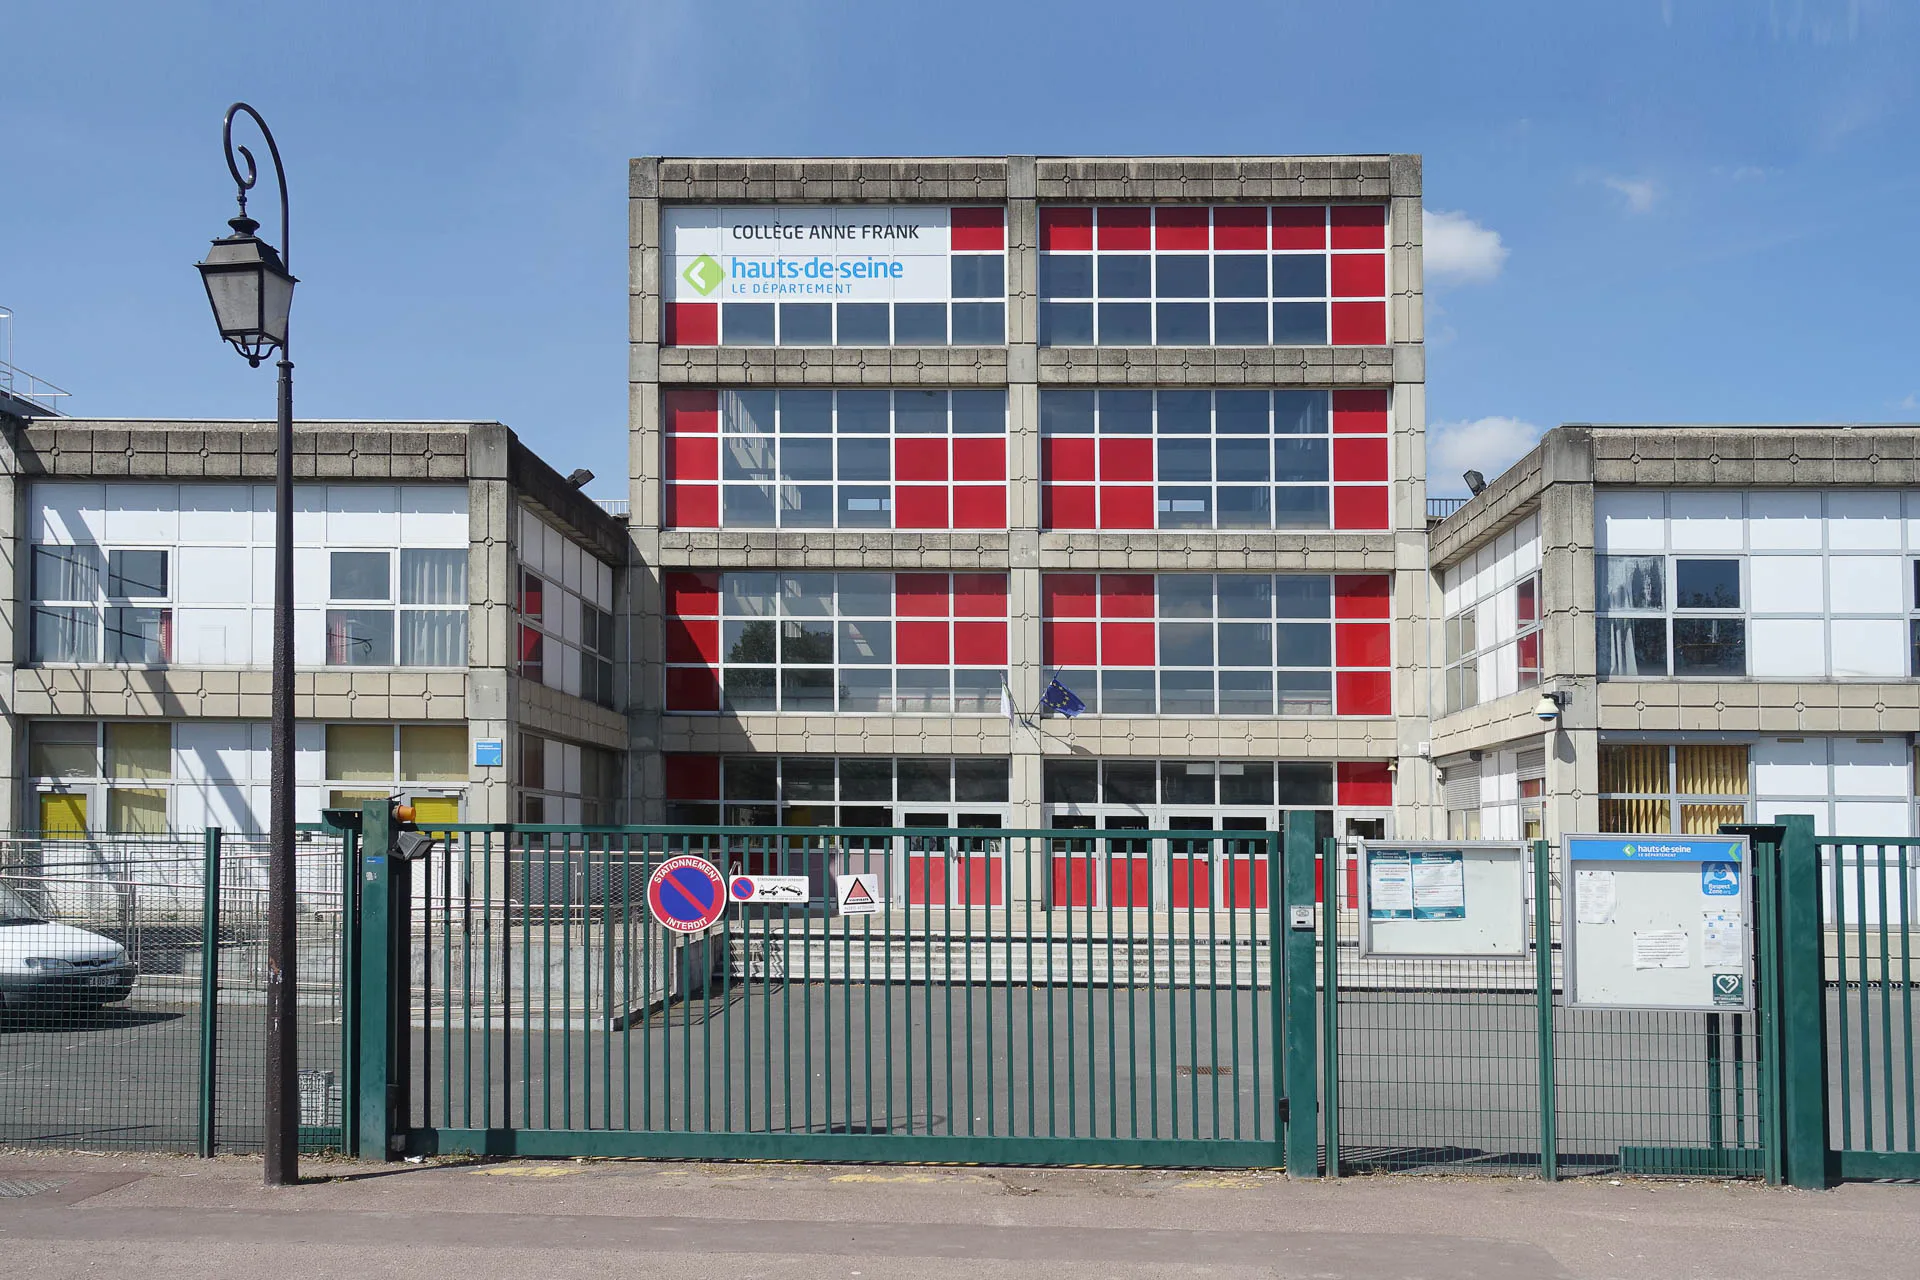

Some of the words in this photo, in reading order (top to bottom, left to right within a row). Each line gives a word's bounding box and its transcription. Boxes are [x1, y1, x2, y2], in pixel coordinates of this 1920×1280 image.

[733, 221, 804, 240] COLLÈGE
[809, 224, 856, 240] ANNE
[862, 224, 920, 240] FRANK
[731, 283, 747, 294] LE
[752, 281, 853, 294] DÉPARTEMENT
[654, 859, 720, 884] STATIONNEMENT
[666, 916, 708, 930] INTERDIT
